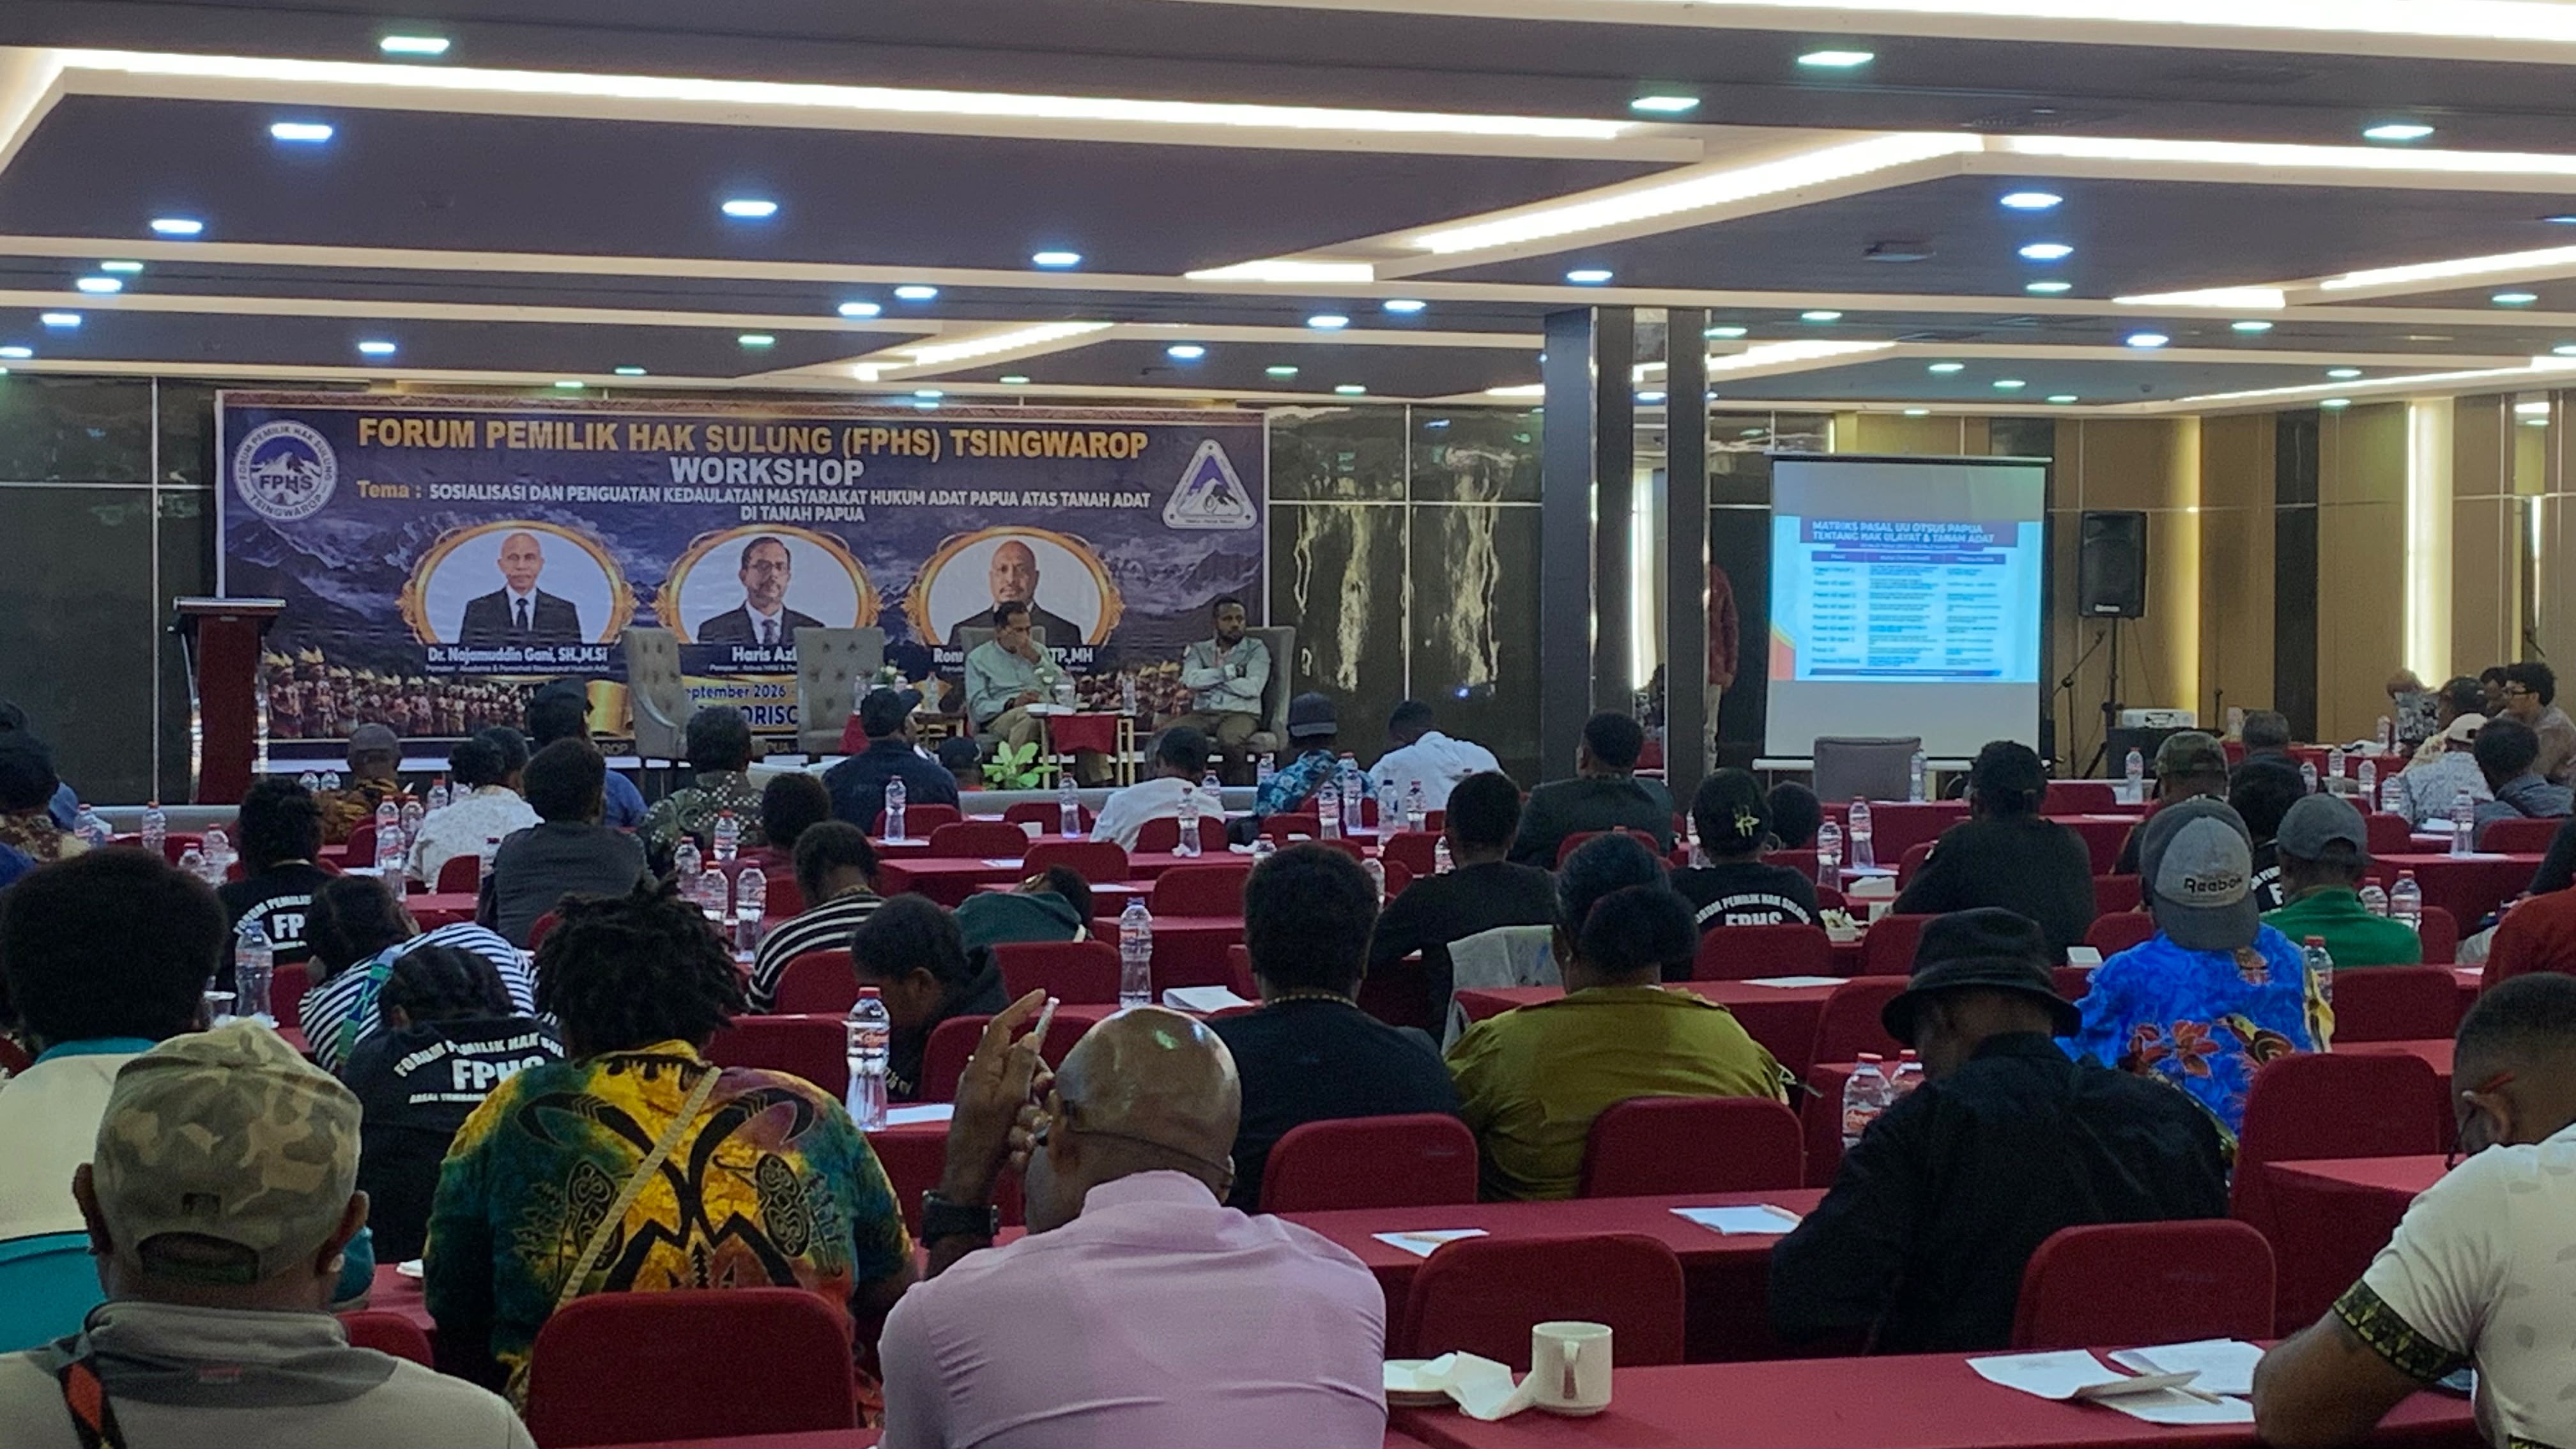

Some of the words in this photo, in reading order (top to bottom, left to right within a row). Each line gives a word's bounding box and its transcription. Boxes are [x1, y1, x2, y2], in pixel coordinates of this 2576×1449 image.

[358, 418, 475, 447] FORUM
[486, 420, 618, 451] PEMILIK
[629, 424, 696, 451] HAK
[705, 425, 832, 454] SULUNG
[842, 427, 941, 463] (FPHS)
[949, 429, 1148, 459] TSINGWAROP
[670, 456, 865, 486] WORKSHOP
[259, 474, 313, 491] FPHS
[356, 480, 410, 498] Tema
[429, 483, 526, 502] SOSIALISASI
[530, 486, 564, 501] DAN
[567, 486, 659, 502] PENGUATAN
[664, 487, 763, 503] KEDAULATAN
[767, 488, 868, 505] MASYARAKAT
[870, 491, 926, 505] HUKUM
[928, 491, 967, 507] ADAT
[970, 491, 1018, 507] PAPUA
[1022, 491, 1057, 507] ATAS
[1061, 492, 1110, 508] TANAH
[1112, 493, 1151, 509] ADAT
[250, 494, 321, 517] TSINGWAROP
[741, 506, 757, 521] DI
[760, 506, 812, 522] TANAH
[815, 507, 865, 522] PAPUA
[1860, 522, 1892, 532] PASAL
[448, 647, 523, 664] Najamuddin
[732, 646, 770, 662] Haris
[754, 684, 786, 698] 2026
[394, 1042, 446, 1078] FORUM
[508, 1032, 540, 1051] HAK
